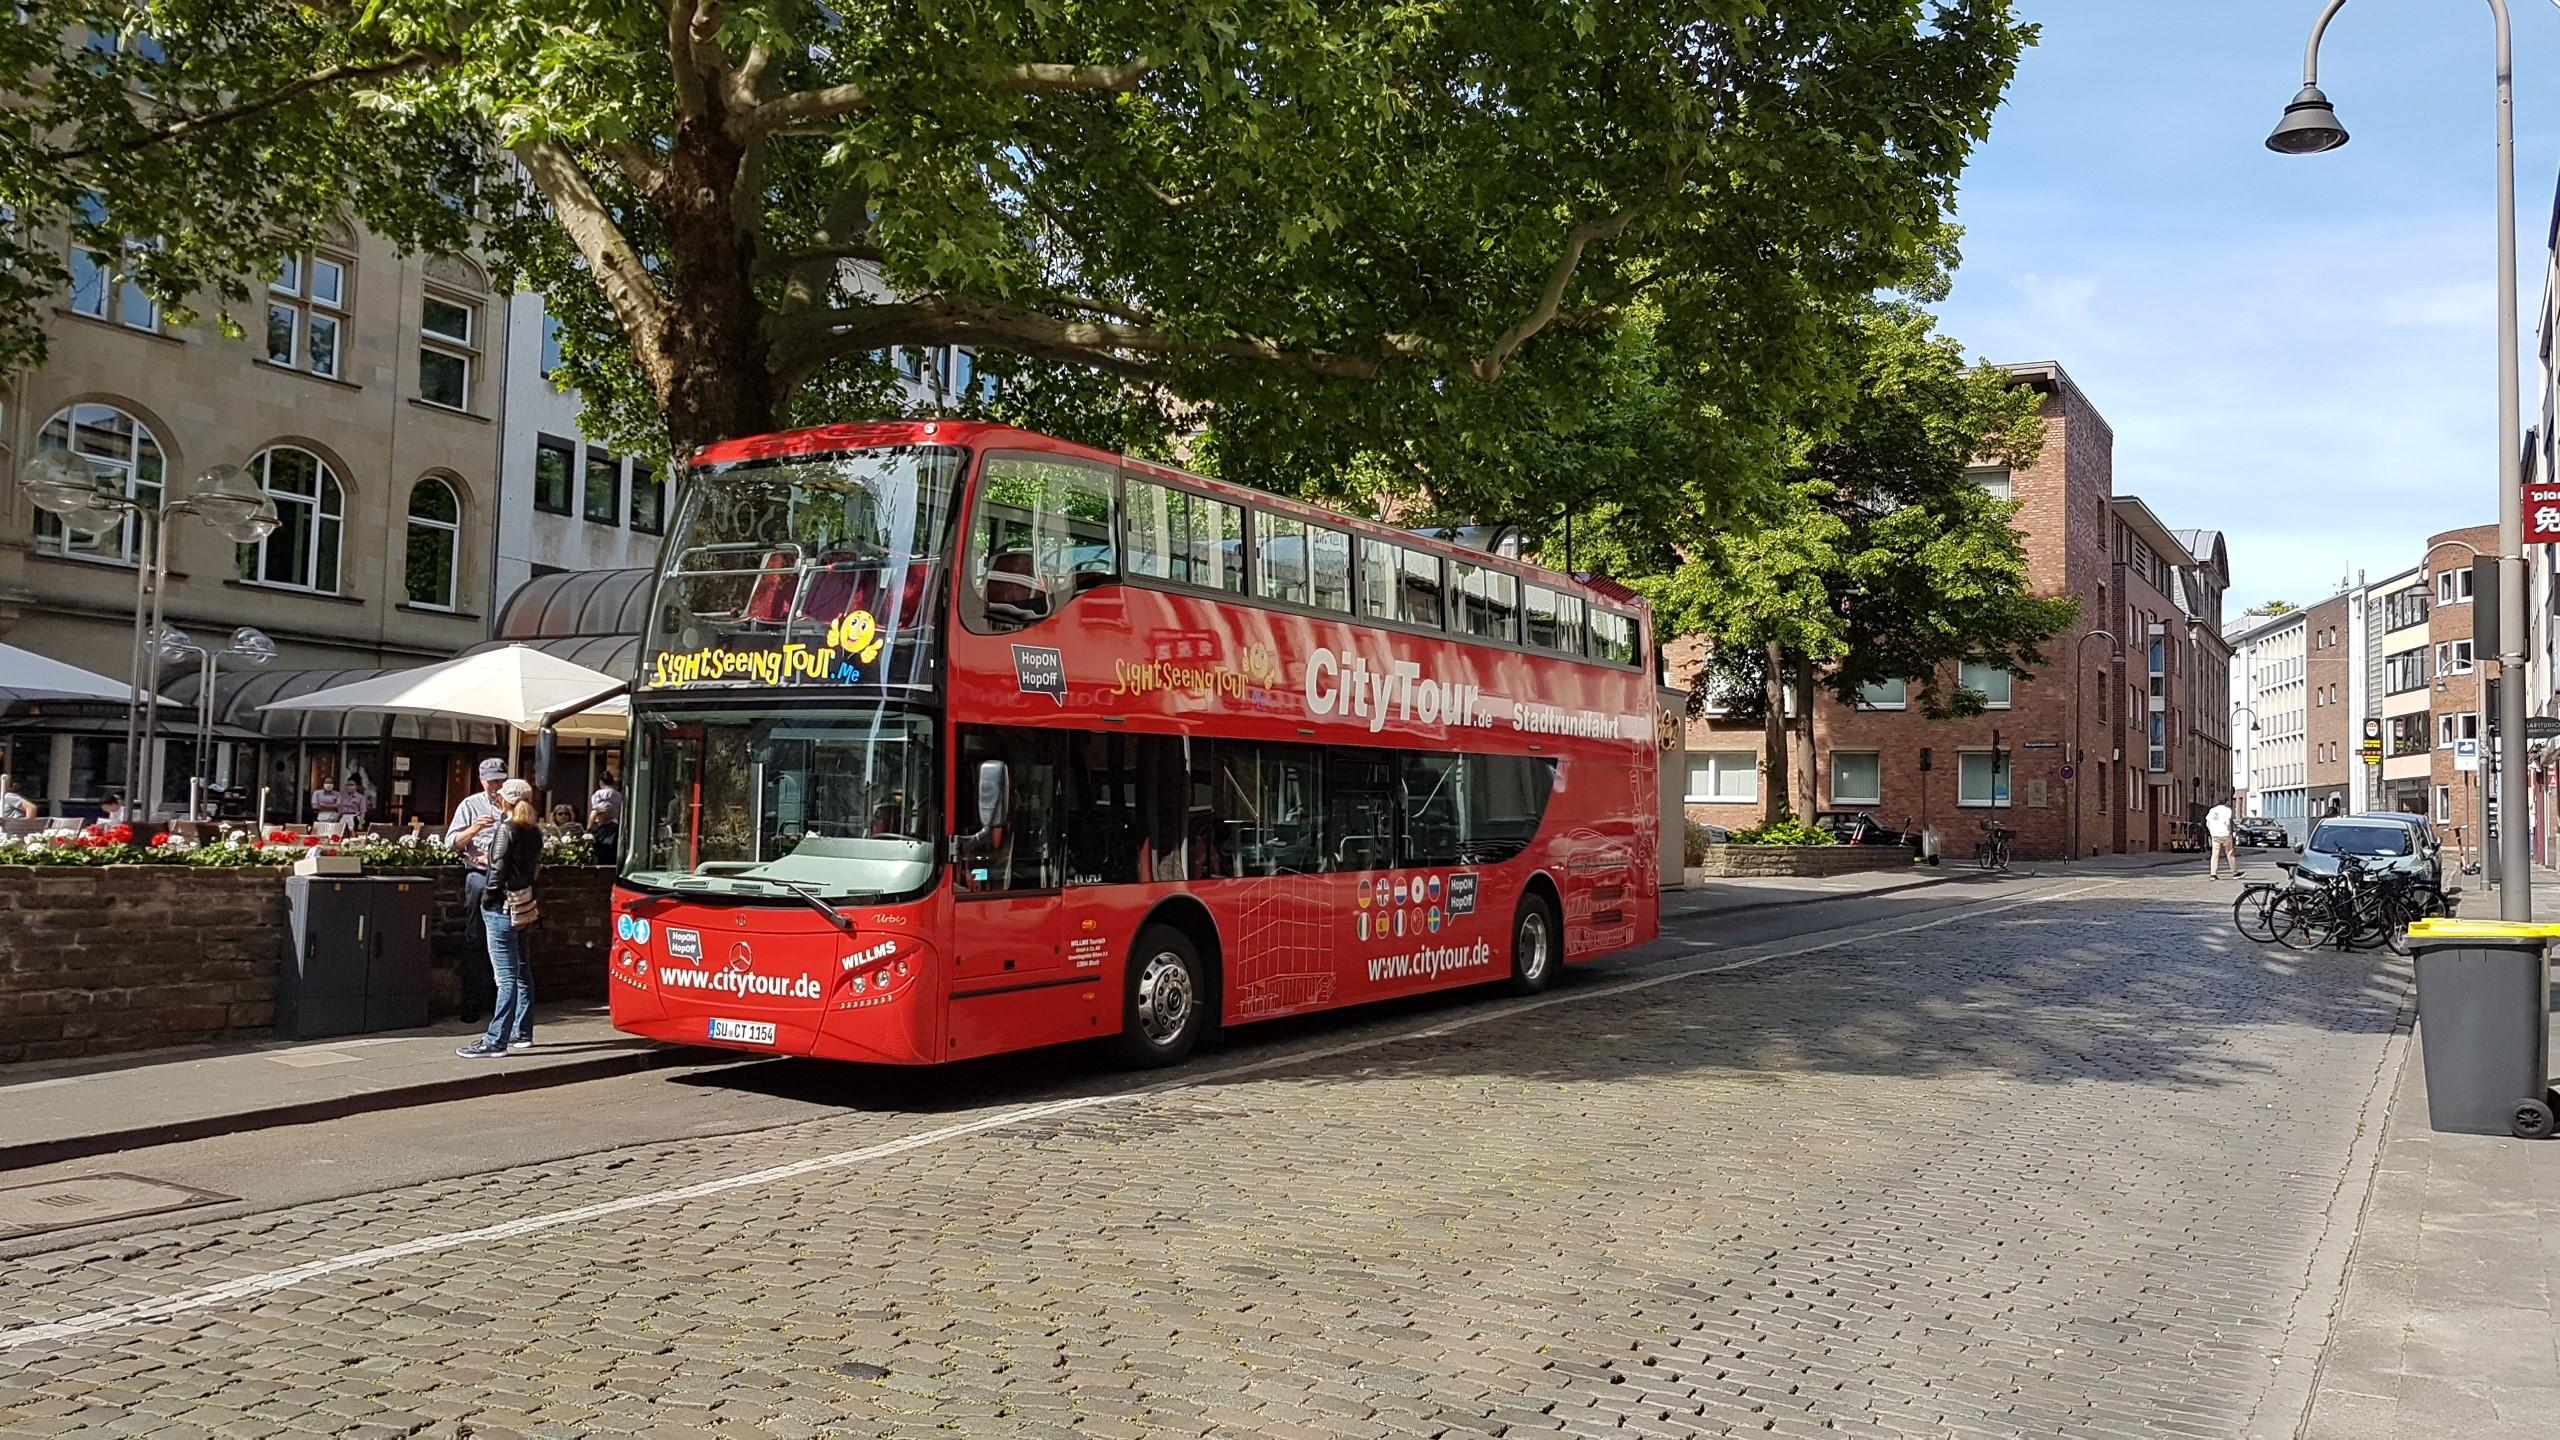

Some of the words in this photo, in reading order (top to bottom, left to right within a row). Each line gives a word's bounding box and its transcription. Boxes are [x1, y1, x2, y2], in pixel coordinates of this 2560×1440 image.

[1021, 651, 1057, 668] HopON
[1021, 670, 1058, 688] HopOff
[1512, 703, 1620, 740] Stadtrundfahrt
[1450, 878, 1473, 893] HopON
[1450, 894, 1473, 910] HopOff
[672, 931, 697, 943] HopON
[671, 942, 697, 954] HopOff
[841, 940, 897, 970] WILLMS
[1368, 936, 1490, 981] www.citytour.de
[660, 967, 821, 999] www.citytour.de
[716, 1022, 728, 1037] SU
[734, 1023, 747, 1039] CT
[749, 1025, 773, 1041] 1154
